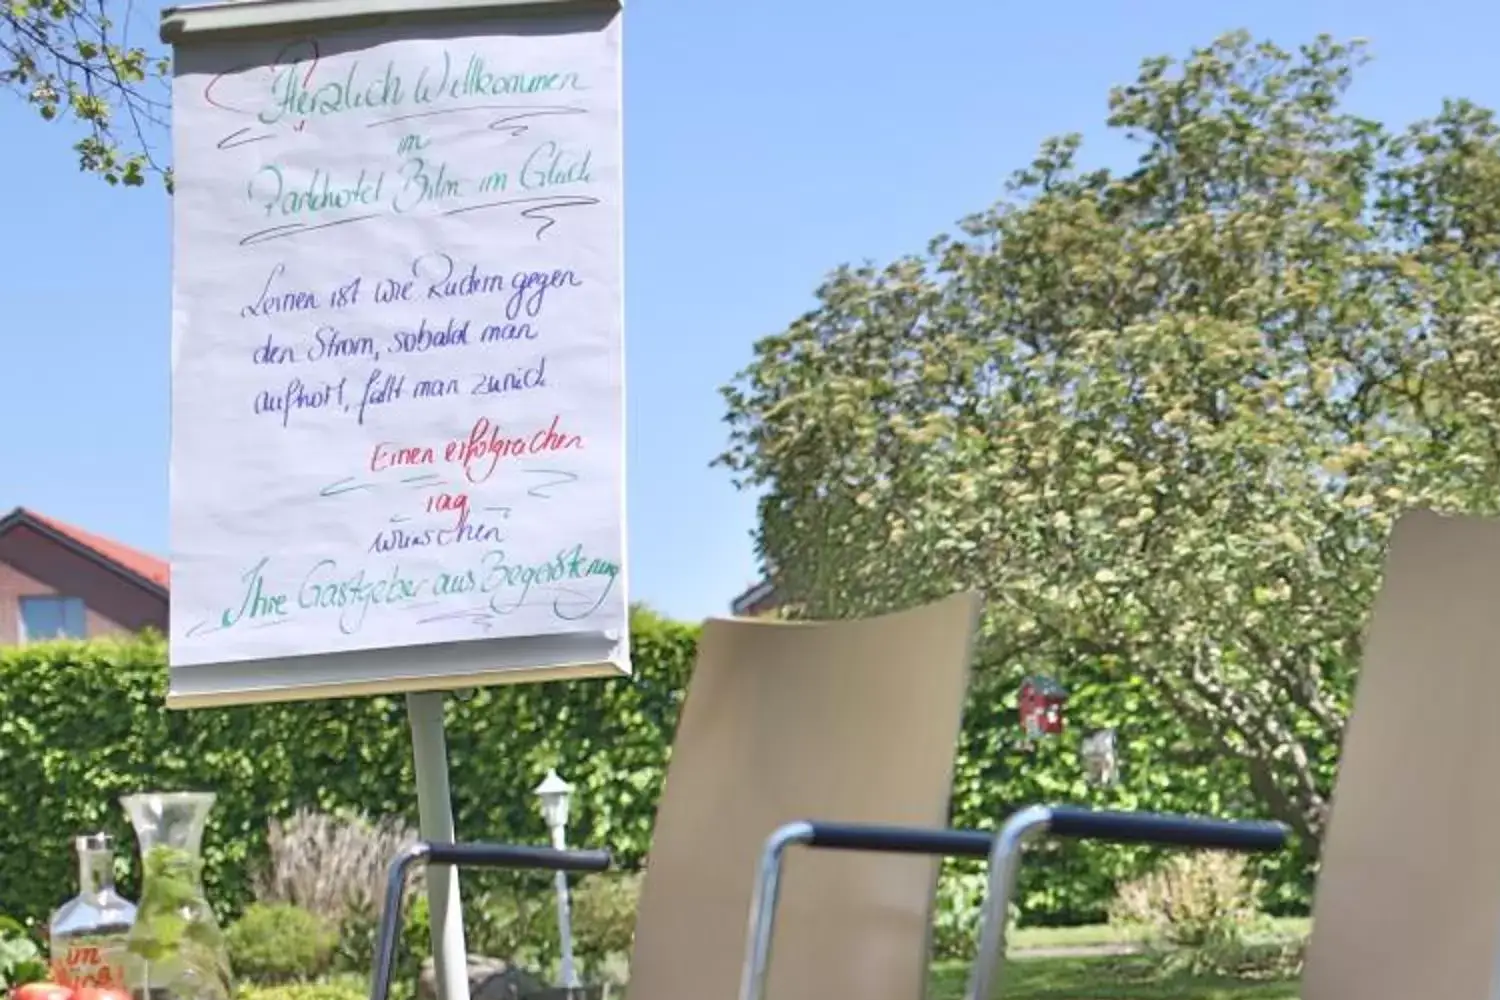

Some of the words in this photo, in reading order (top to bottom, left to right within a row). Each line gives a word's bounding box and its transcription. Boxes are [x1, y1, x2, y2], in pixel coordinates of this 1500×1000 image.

[259, 58, 403, 124] Herzlich
[415, 50, 590, 104] Willkommen
[248, 164, 385, 217] Parkhotel
[240, 262, 319, 318] Lernen
[329, 276, 361, 309] ist
[374, 278, 413, 304] wie
[412, 252, 503, 300] Rudern
[505, 269, 583, 321] gegen
[253, 333, 297, 365] den
[387, 318, 471, 353] sobald
[480, 322, 539, 344] man
[413, 377, 459, 400] man
[371, 441, 435, 472] Einen
[221, 556, 289, 628] Ihre
[433, 570, 476, 595] aus
